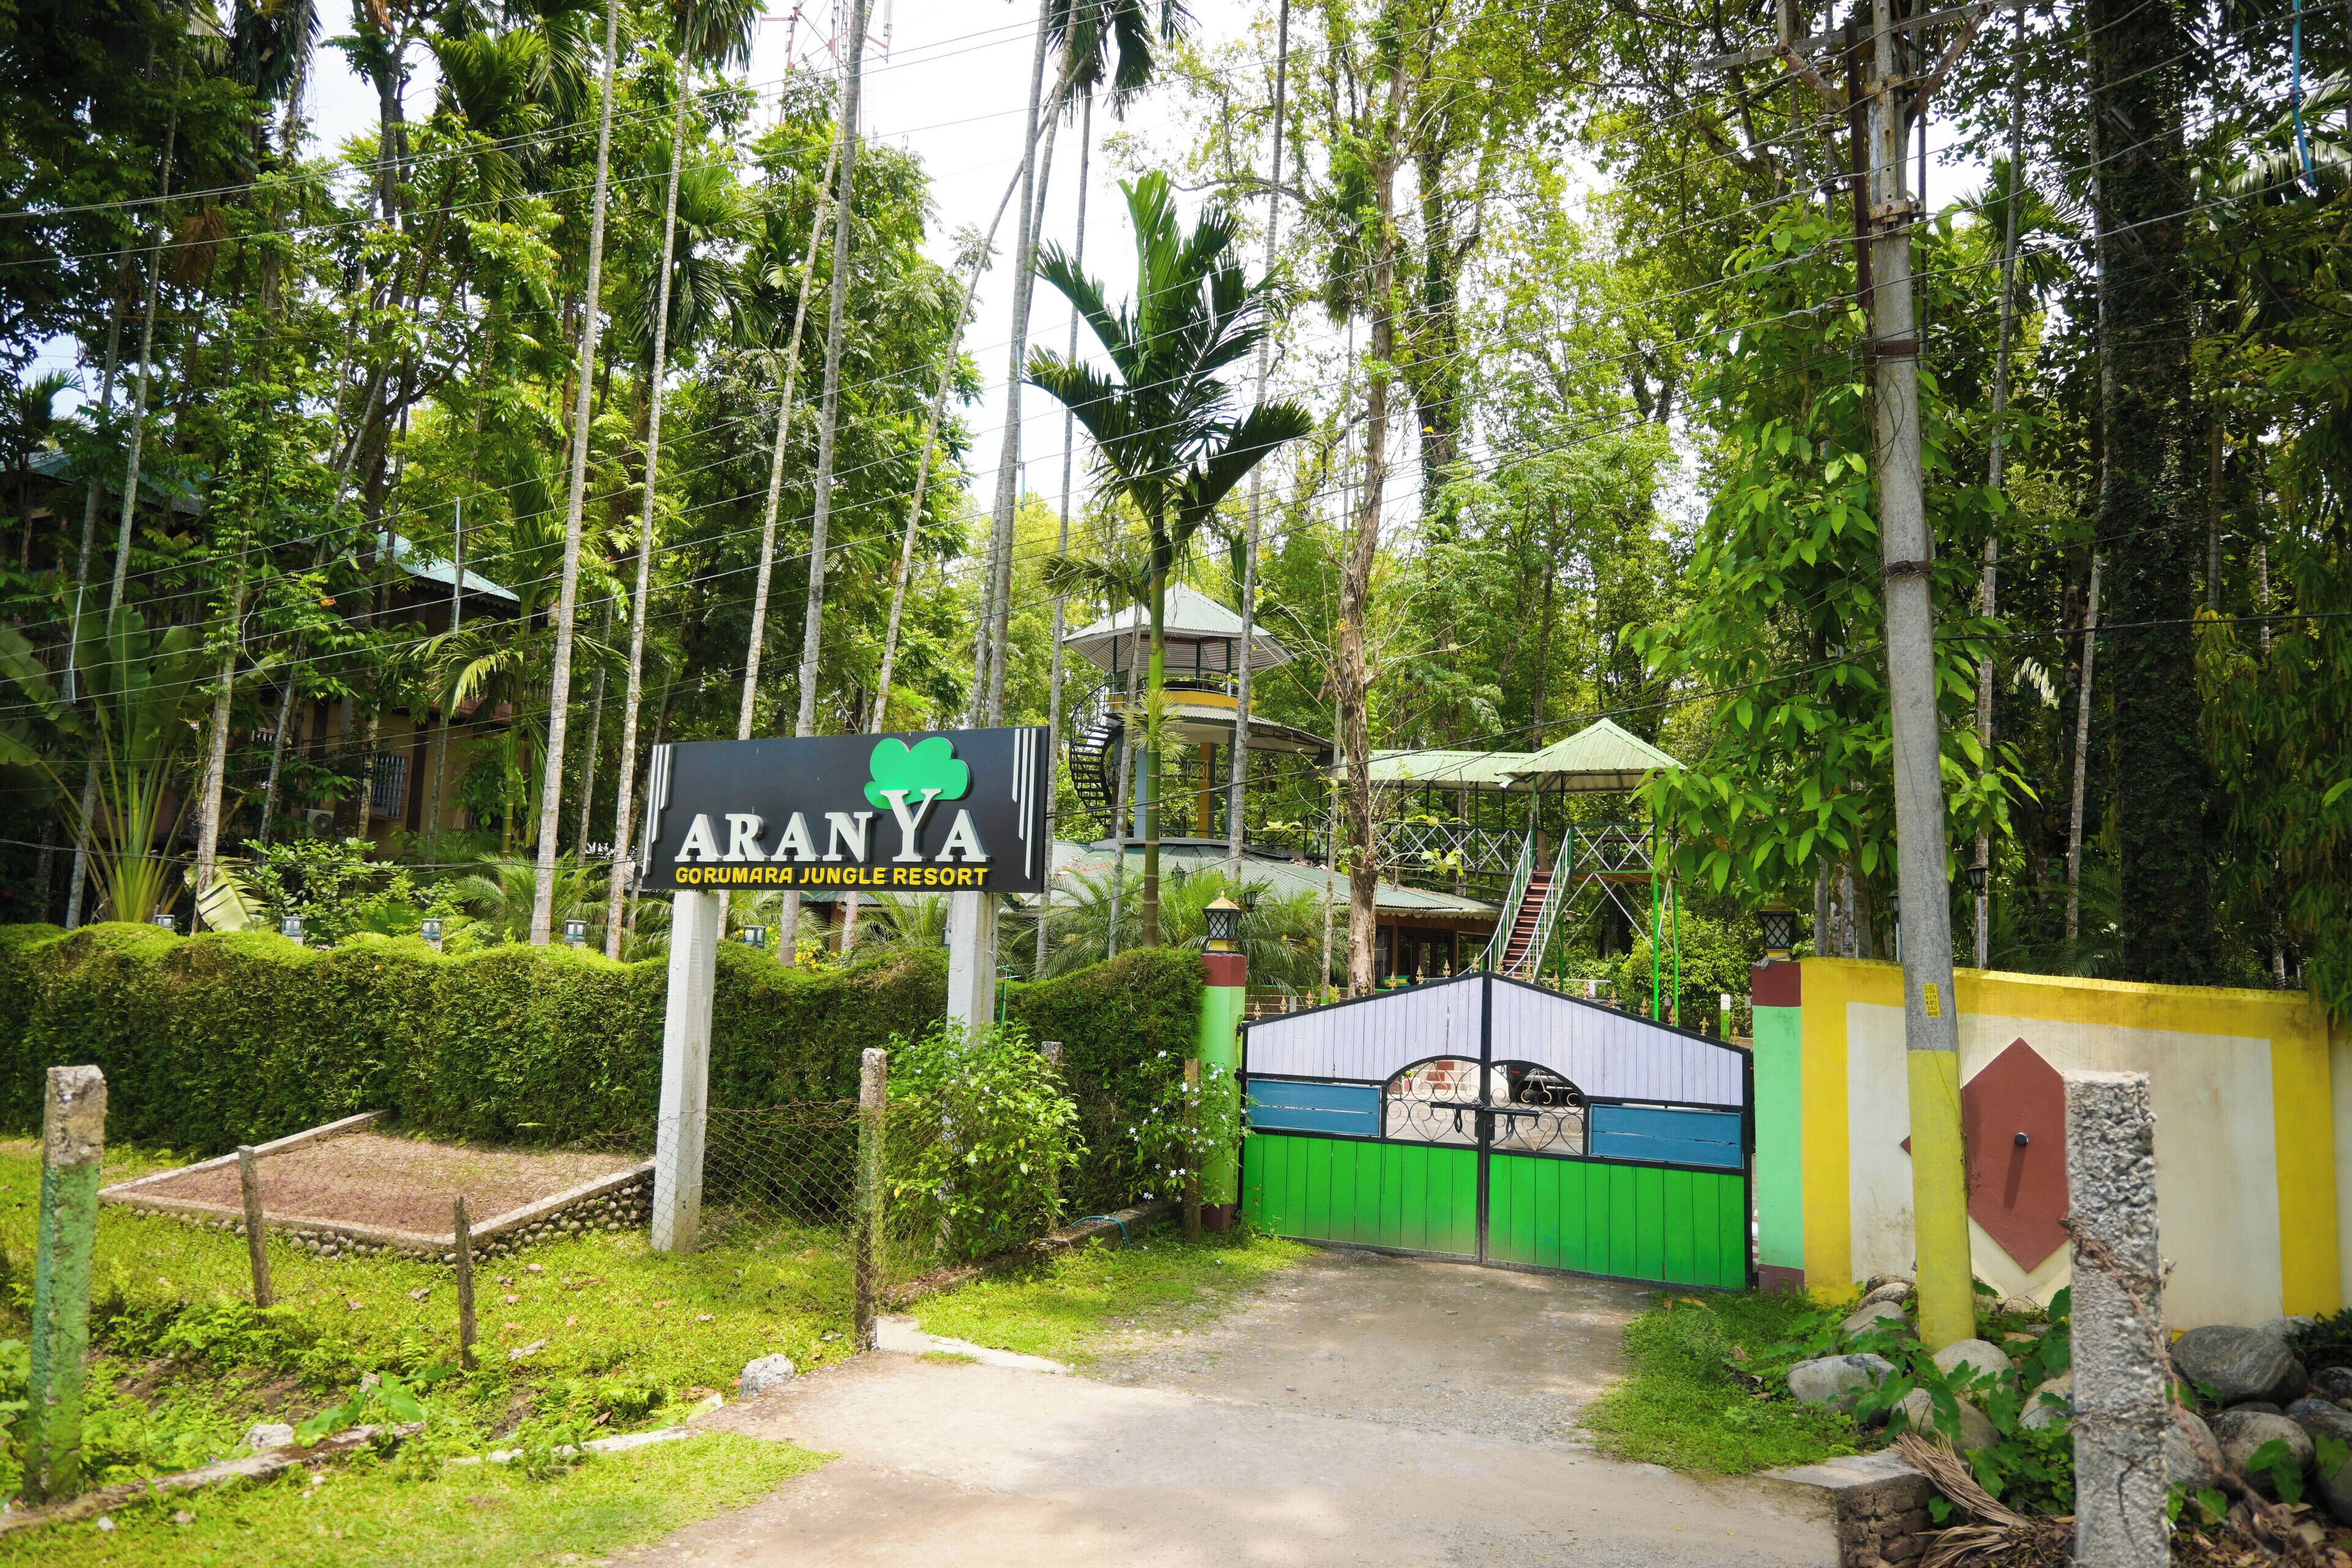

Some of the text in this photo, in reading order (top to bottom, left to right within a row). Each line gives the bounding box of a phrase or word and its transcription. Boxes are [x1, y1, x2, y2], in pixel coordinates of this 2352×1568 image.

[674, 788, 990, 863] ARANYA
[676, 867, 989, 886] GORUMARA JUNGLE RESORT
